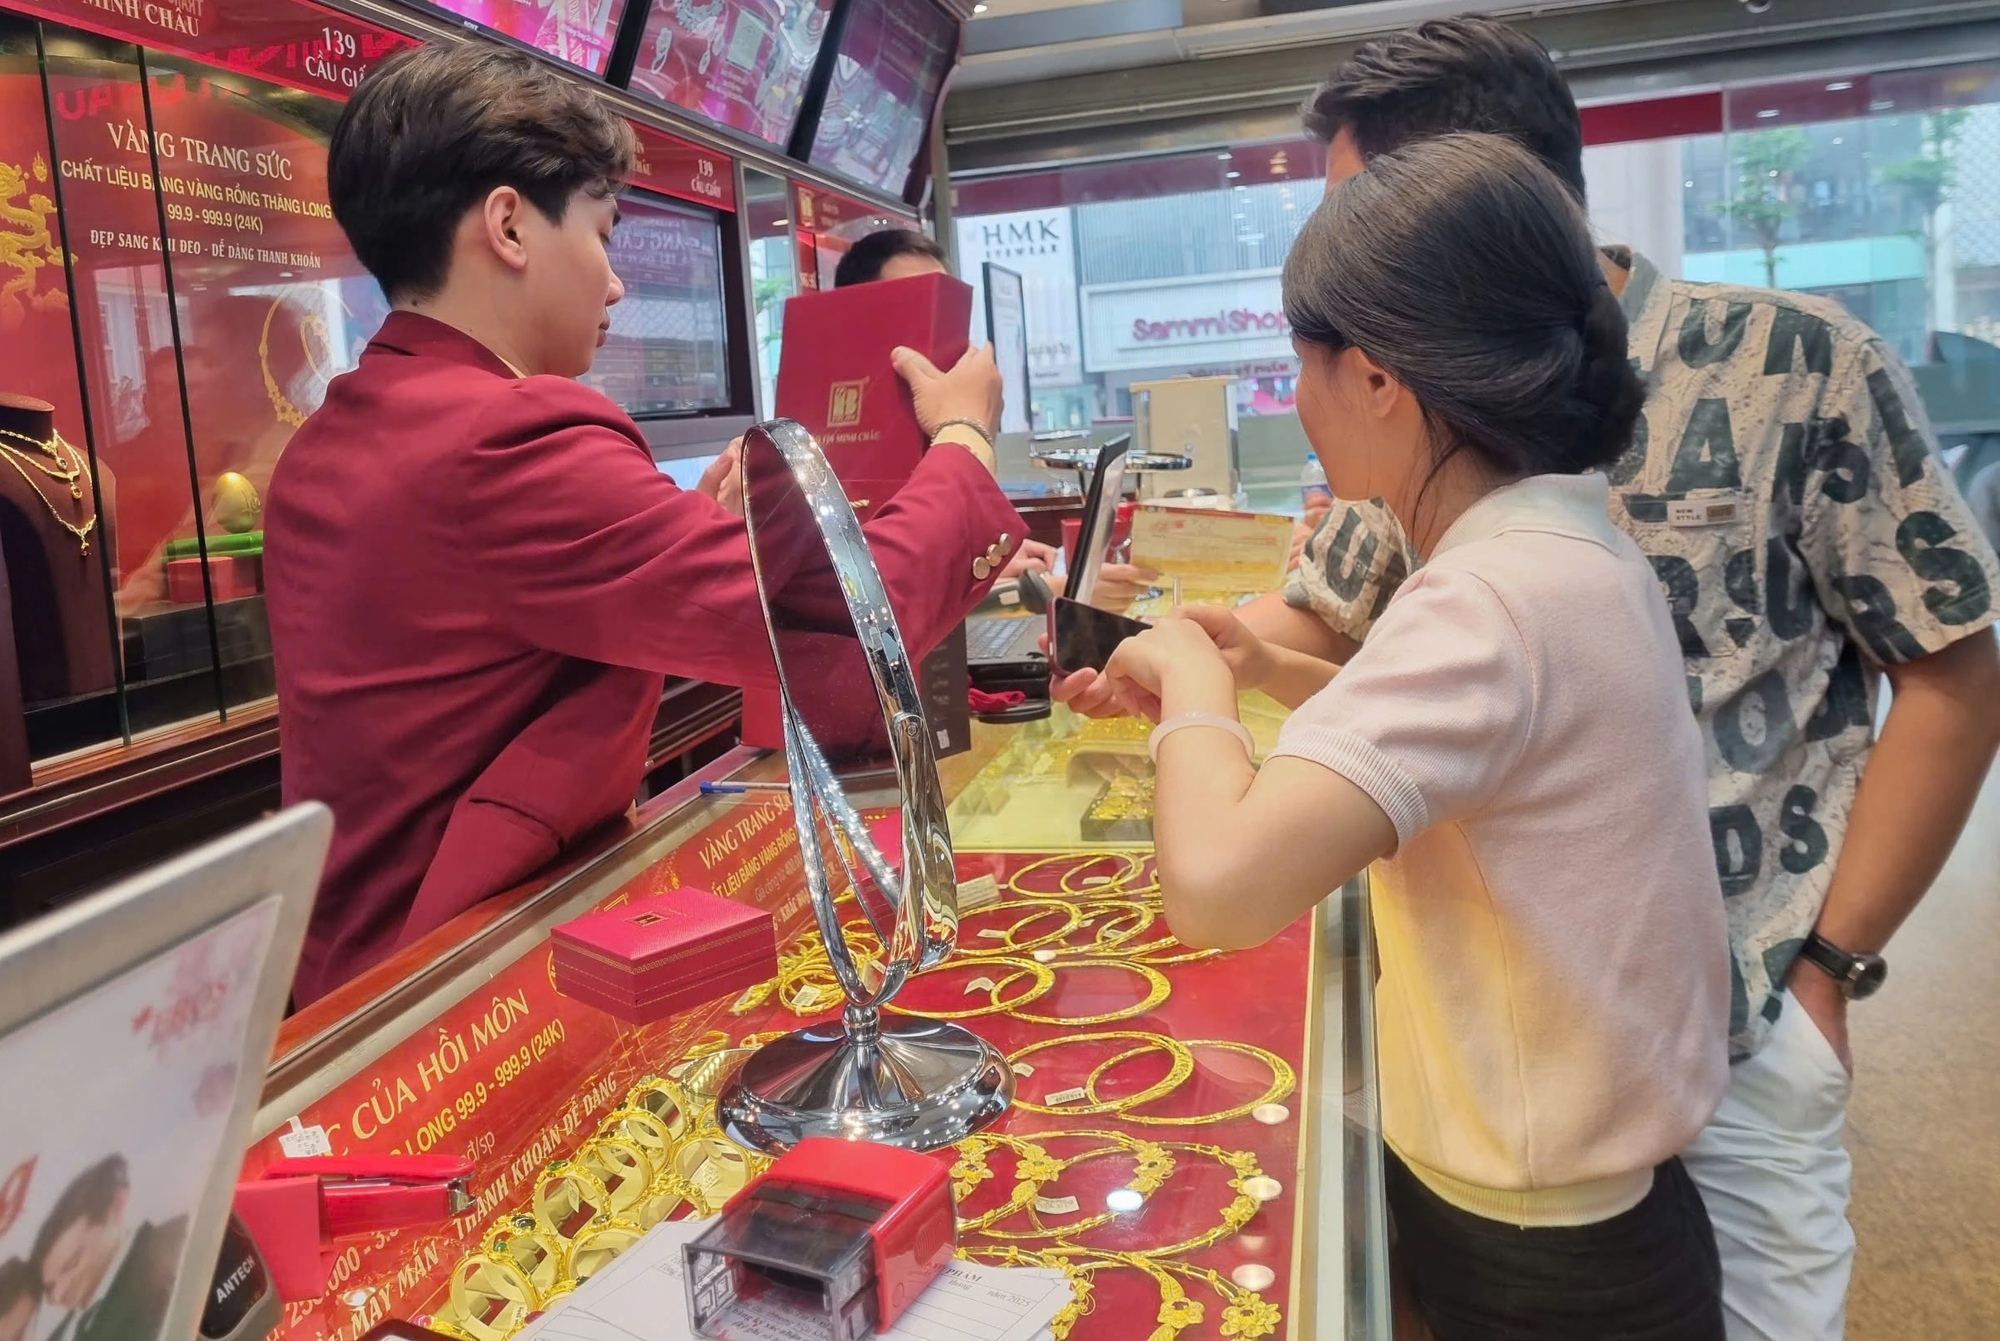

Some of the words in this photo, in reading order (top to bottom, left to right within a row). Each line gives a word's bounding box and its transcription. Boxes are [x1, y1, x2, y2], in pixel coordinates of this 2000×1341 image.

[83, 0, 141, 20] INH
[145, 4, 199, 37] CHÂU
[322, 27, 355, 58] 139
[305, 49, 337, 82] CẦU
[341, 64, 366, 88] GIẤ
[107, 119, 175, 158] VÀNG
[181, 137, 250, 172] TRANG
[256, 150, 292, 180] SỨC
[698, 159, 713, 177] 139
[61, 157, 102, 182] CHẤT
[107, 165, 138, 189] LIỆU
[187, 178, 223, 200] VÀNG
[262, 193, 300, 213] THĂNG
[302, 201, 332, 218] LONG
[168, 204, 193, 221] 99.9
[202, 209, 232, 227] 999.9
[235, 213, 263, 235] (24K)
[982, 218, 1059, 246] HMK
[90, 229, 114, 249] ĐẸP
[118, 233, 148, 249] SANG
[180, 240, 200, 254] ĐEO
[228, 242, 254, 260] DÀNG
[257, 249, 288, 265] THANH
[291, 252, 320, 268] KHOẢN
[699, 837, 738, 870] VÀNG
[735, 802, 776, 842] TRANG
[353, 1076, 418, 1139] CỦA
[417, 1027, 470, 1092] HỒI
[471, 988, 529, 1053] MÔN
[405, 1108, 457, 1156] LONG
[456, 1082, 487, 1120] 99.9
[494, 1046, 532, 1088] 999.9
[530, 1018, 565, 1062] (24K)
[352, 1282, 392, 1341] MAY
[397, 1240, 439, 1298] MẮN
[511, 1123, 562, 1187] KHOẢN
[582, 1072, 617, 1117] DÀNG
[216, 1255, 255, 1304] ANTECH
[987, 1290, 1006, 1300] năm
[1007, 1296, 1031, 1307] 2025
